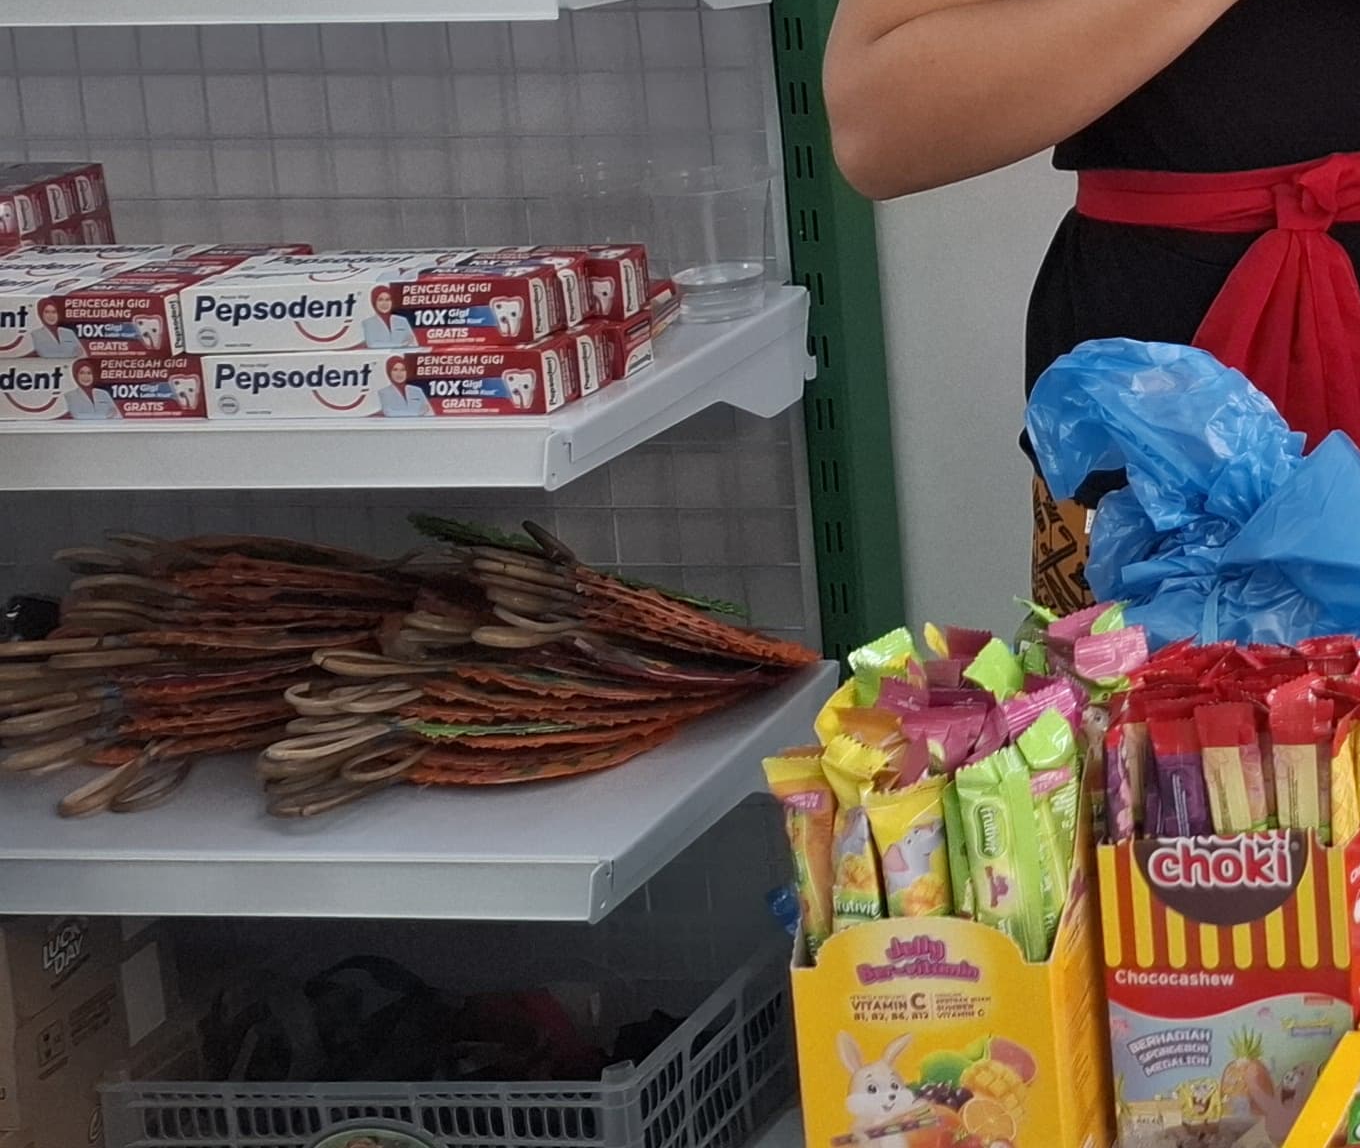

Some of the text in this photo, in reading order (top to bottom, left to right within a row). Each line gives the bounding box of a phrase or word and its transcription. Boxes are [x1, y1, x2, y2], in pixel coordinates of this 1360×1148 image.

[402, 283, 491, 294] PENCEGAH GIGI
[65, 299, 150, 308] PENCEGAH GIGI
[402, 294, 471, 305] BERLUBANG
[65, 309, 131, 318] BERLUBANG
[195, 293, 356, 326] Pepsodent
[414, 309, 447, 325] 10X
[76, 324, 104, 337] 10X
[427, 328, 469, 338] GRATIS
[89, 342, 129, 351] GRATIS
[101, 359, 187, 368] PENCEGAH GIGI
[417, 355, 504, 365] PENCEGAH GIGI
[101, 369, 168, 379] BERLUBANG
[417, 366, 484, 375] BERLUBANG
[215, 363, 371, 394] Pepsodent
[112, 385, 139, 398] 10X
[428, 380, 461, 395] 10X
[123, 402, 164, 411] GRATIS
[442, 399, 482, 408] GRATIS
[1149, 838, 1292, 886] choki
[1115, 970, 1234, 986] Chococashew
[852, 993, 926, 1011] VITAMIN C
[1129, 1030, 1211, 1053] BERHADIAH
